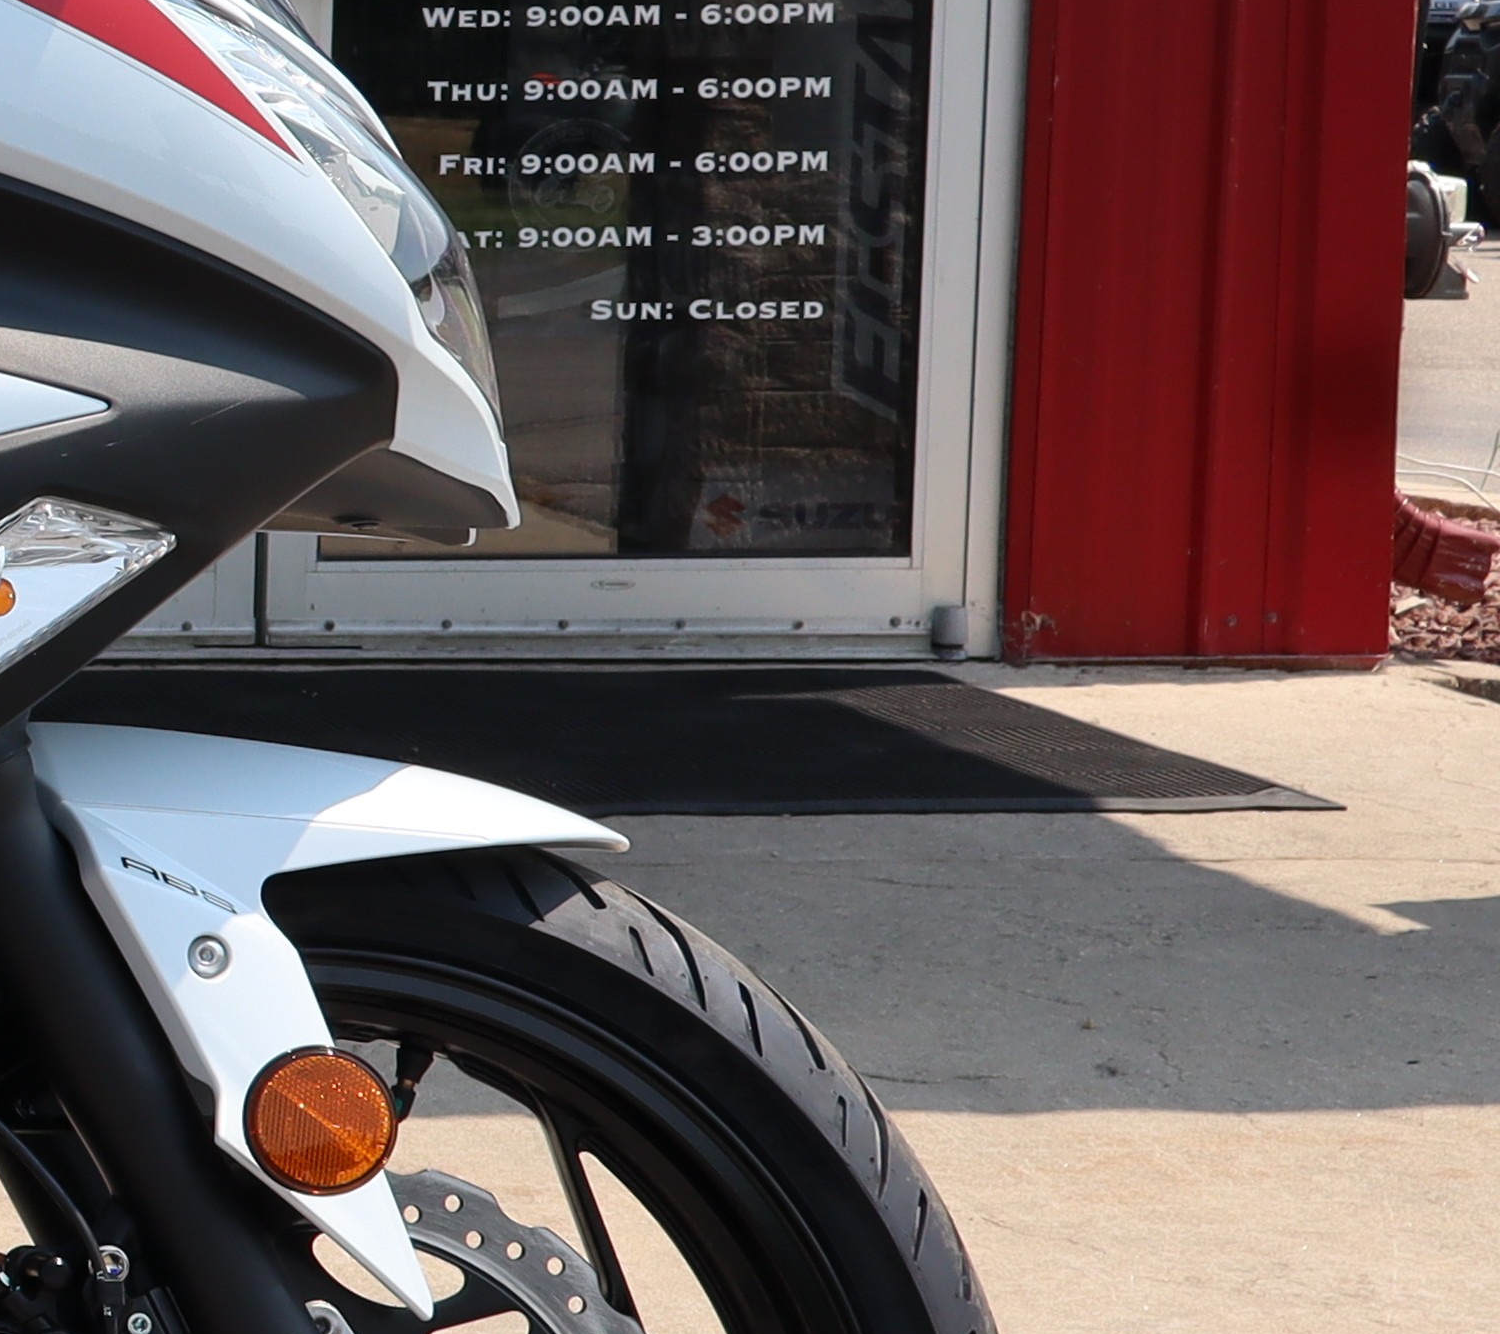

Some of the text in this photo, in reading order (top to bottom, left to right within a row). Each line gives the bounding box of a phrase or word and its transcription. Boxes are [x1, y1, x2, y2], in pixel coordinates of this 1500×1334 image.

[526, 5, 660, 27] 9:00AM
[700, 3, 835, 25] 6:00PM
[523, 79, 657, 101] 9:00AM
[697, 77, 831, 99] 6:00PM
[521, 152, 655, 174] 9:00AM
[695, 151, 828, 173] 6:00PM
[518, 226, 652, 248] 9:00AM
[692, 224, 826, 246] 3:00PM
[120, 855, 239, 915] ABS
